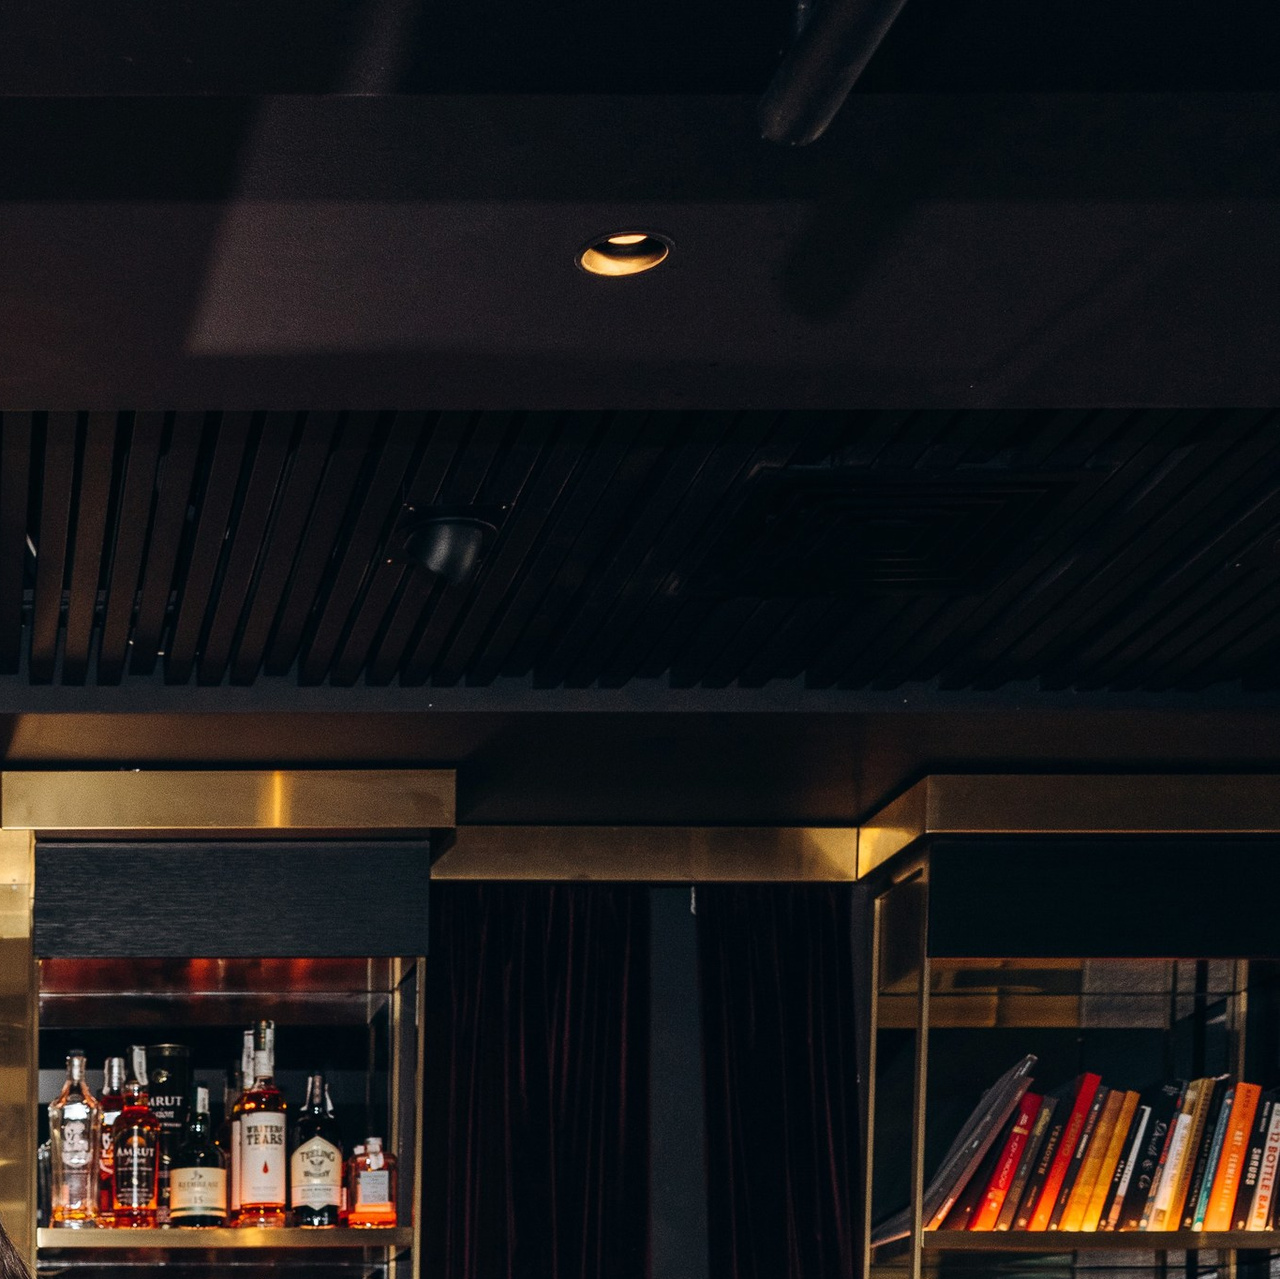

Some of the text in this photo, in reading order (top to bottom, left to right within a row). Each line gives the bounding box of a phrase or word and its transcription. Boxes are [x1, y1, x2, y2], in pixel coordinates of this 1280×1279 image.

[116, 1146, 156, 1157] AMRUT
[246, 1134, 284, 1146] TEARS
[1038, 1125, 1062, 1175] VERMOUTH
[1148, 1119, 1168, 1157] Death
[299, 1149, 336, 1162] TEELING
[1245, 1146, 1263, 1187] SHRUBS
[1260, 1144, 1279, 1191] BOTTLE
[1138, 1174, 1152, 1189] Co
[1255, 1193, 1270, 1221] BAR
